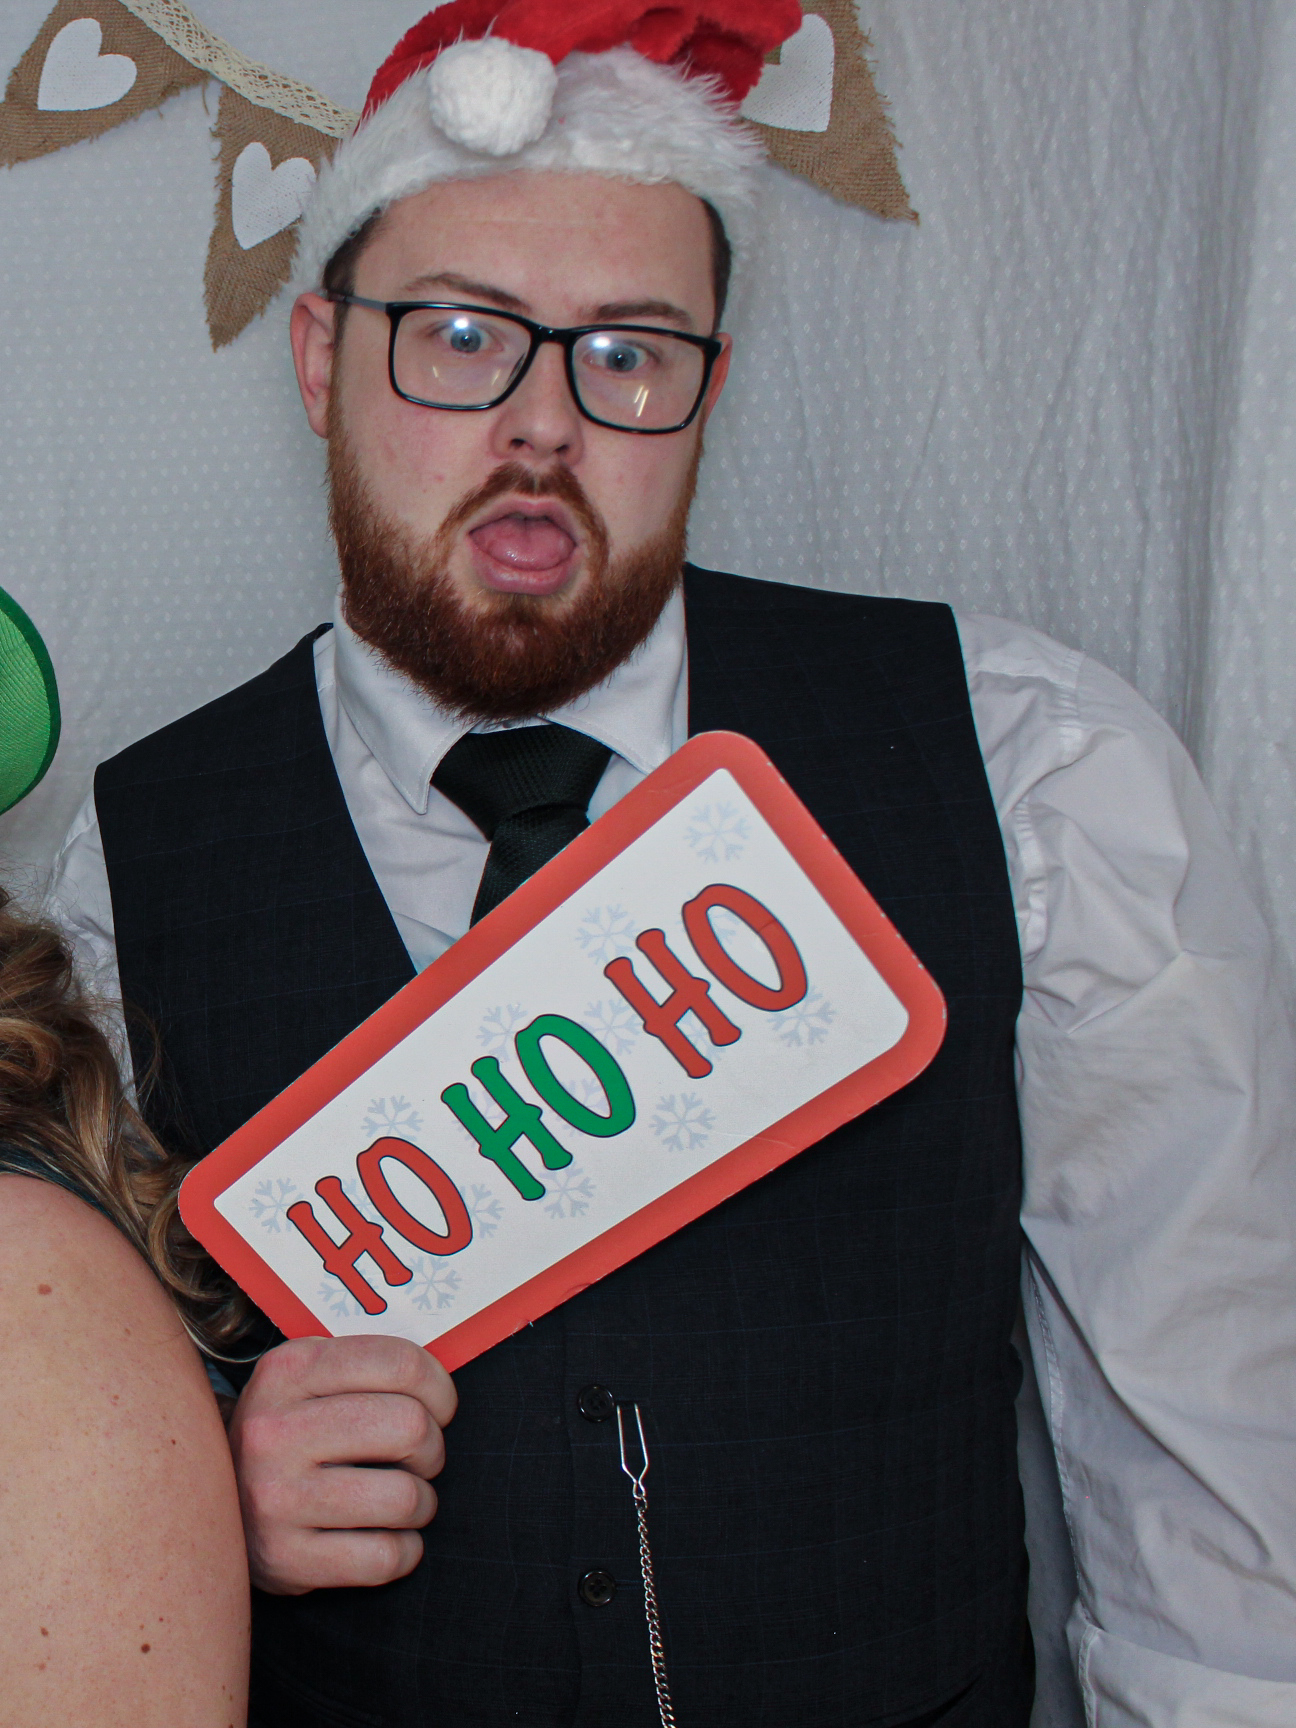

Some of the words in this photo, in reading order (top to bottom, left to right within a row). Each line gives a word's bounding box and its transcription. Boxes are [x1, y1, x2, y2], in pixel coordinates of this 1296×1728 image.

[287, 1136, 473, 1315] HO
[441, 1014, 636, 1200] HO
[604, 883, 808, 1078] HO
